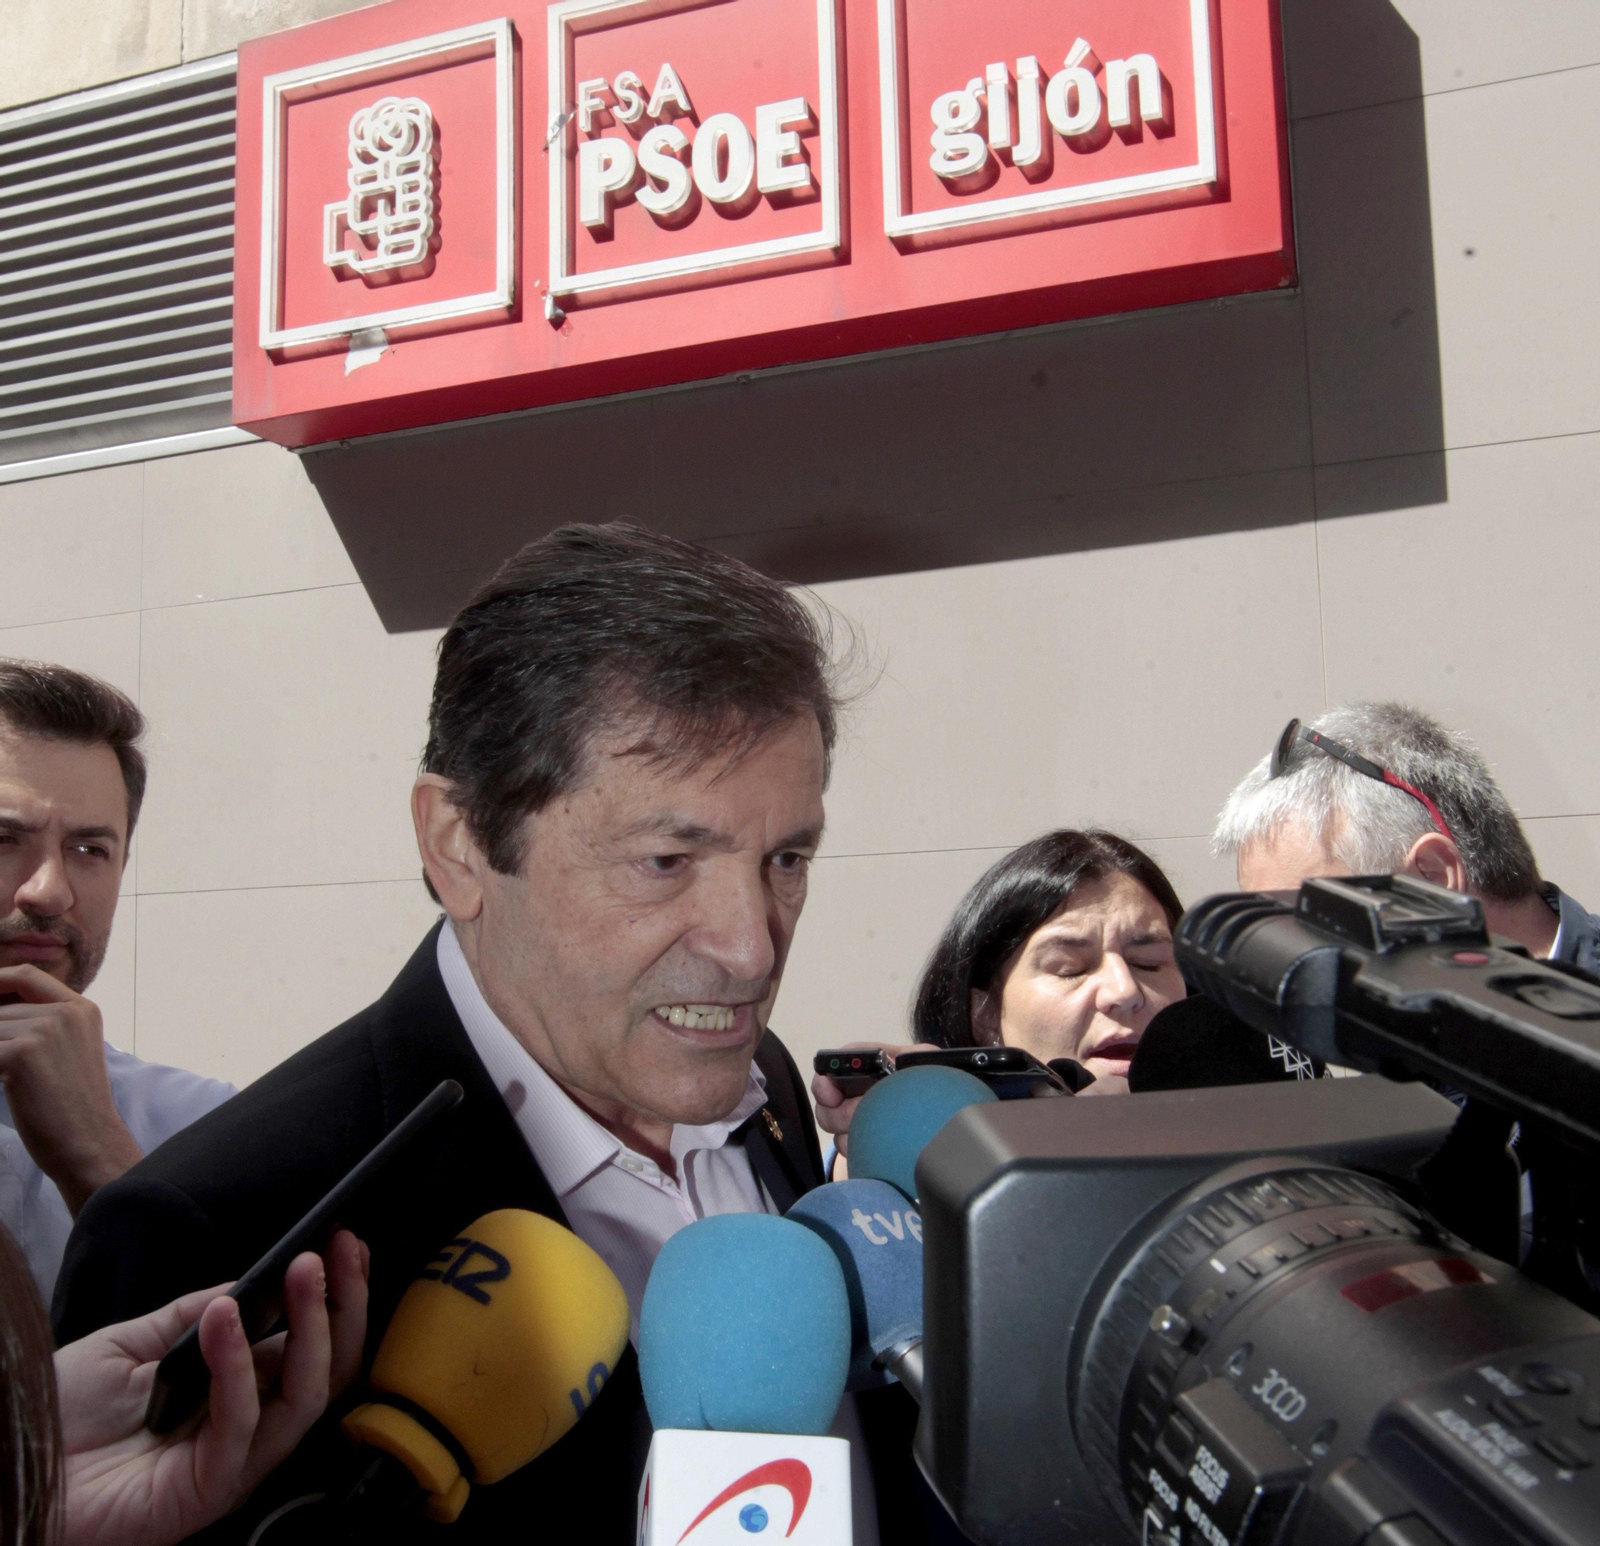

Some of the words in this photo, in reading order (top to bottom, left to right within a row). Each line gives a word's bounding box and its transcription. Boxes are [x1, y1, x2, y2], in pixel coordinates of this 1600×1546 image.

[577, 62, 692, 133] FSA
[928, 37, 1164, 179] gijón
[579, 97, 813, 228] PSOE
[1149, 1467, 1179, 1512] FOCUS
[1195, 1444, 1229, 1489] FOCUS
